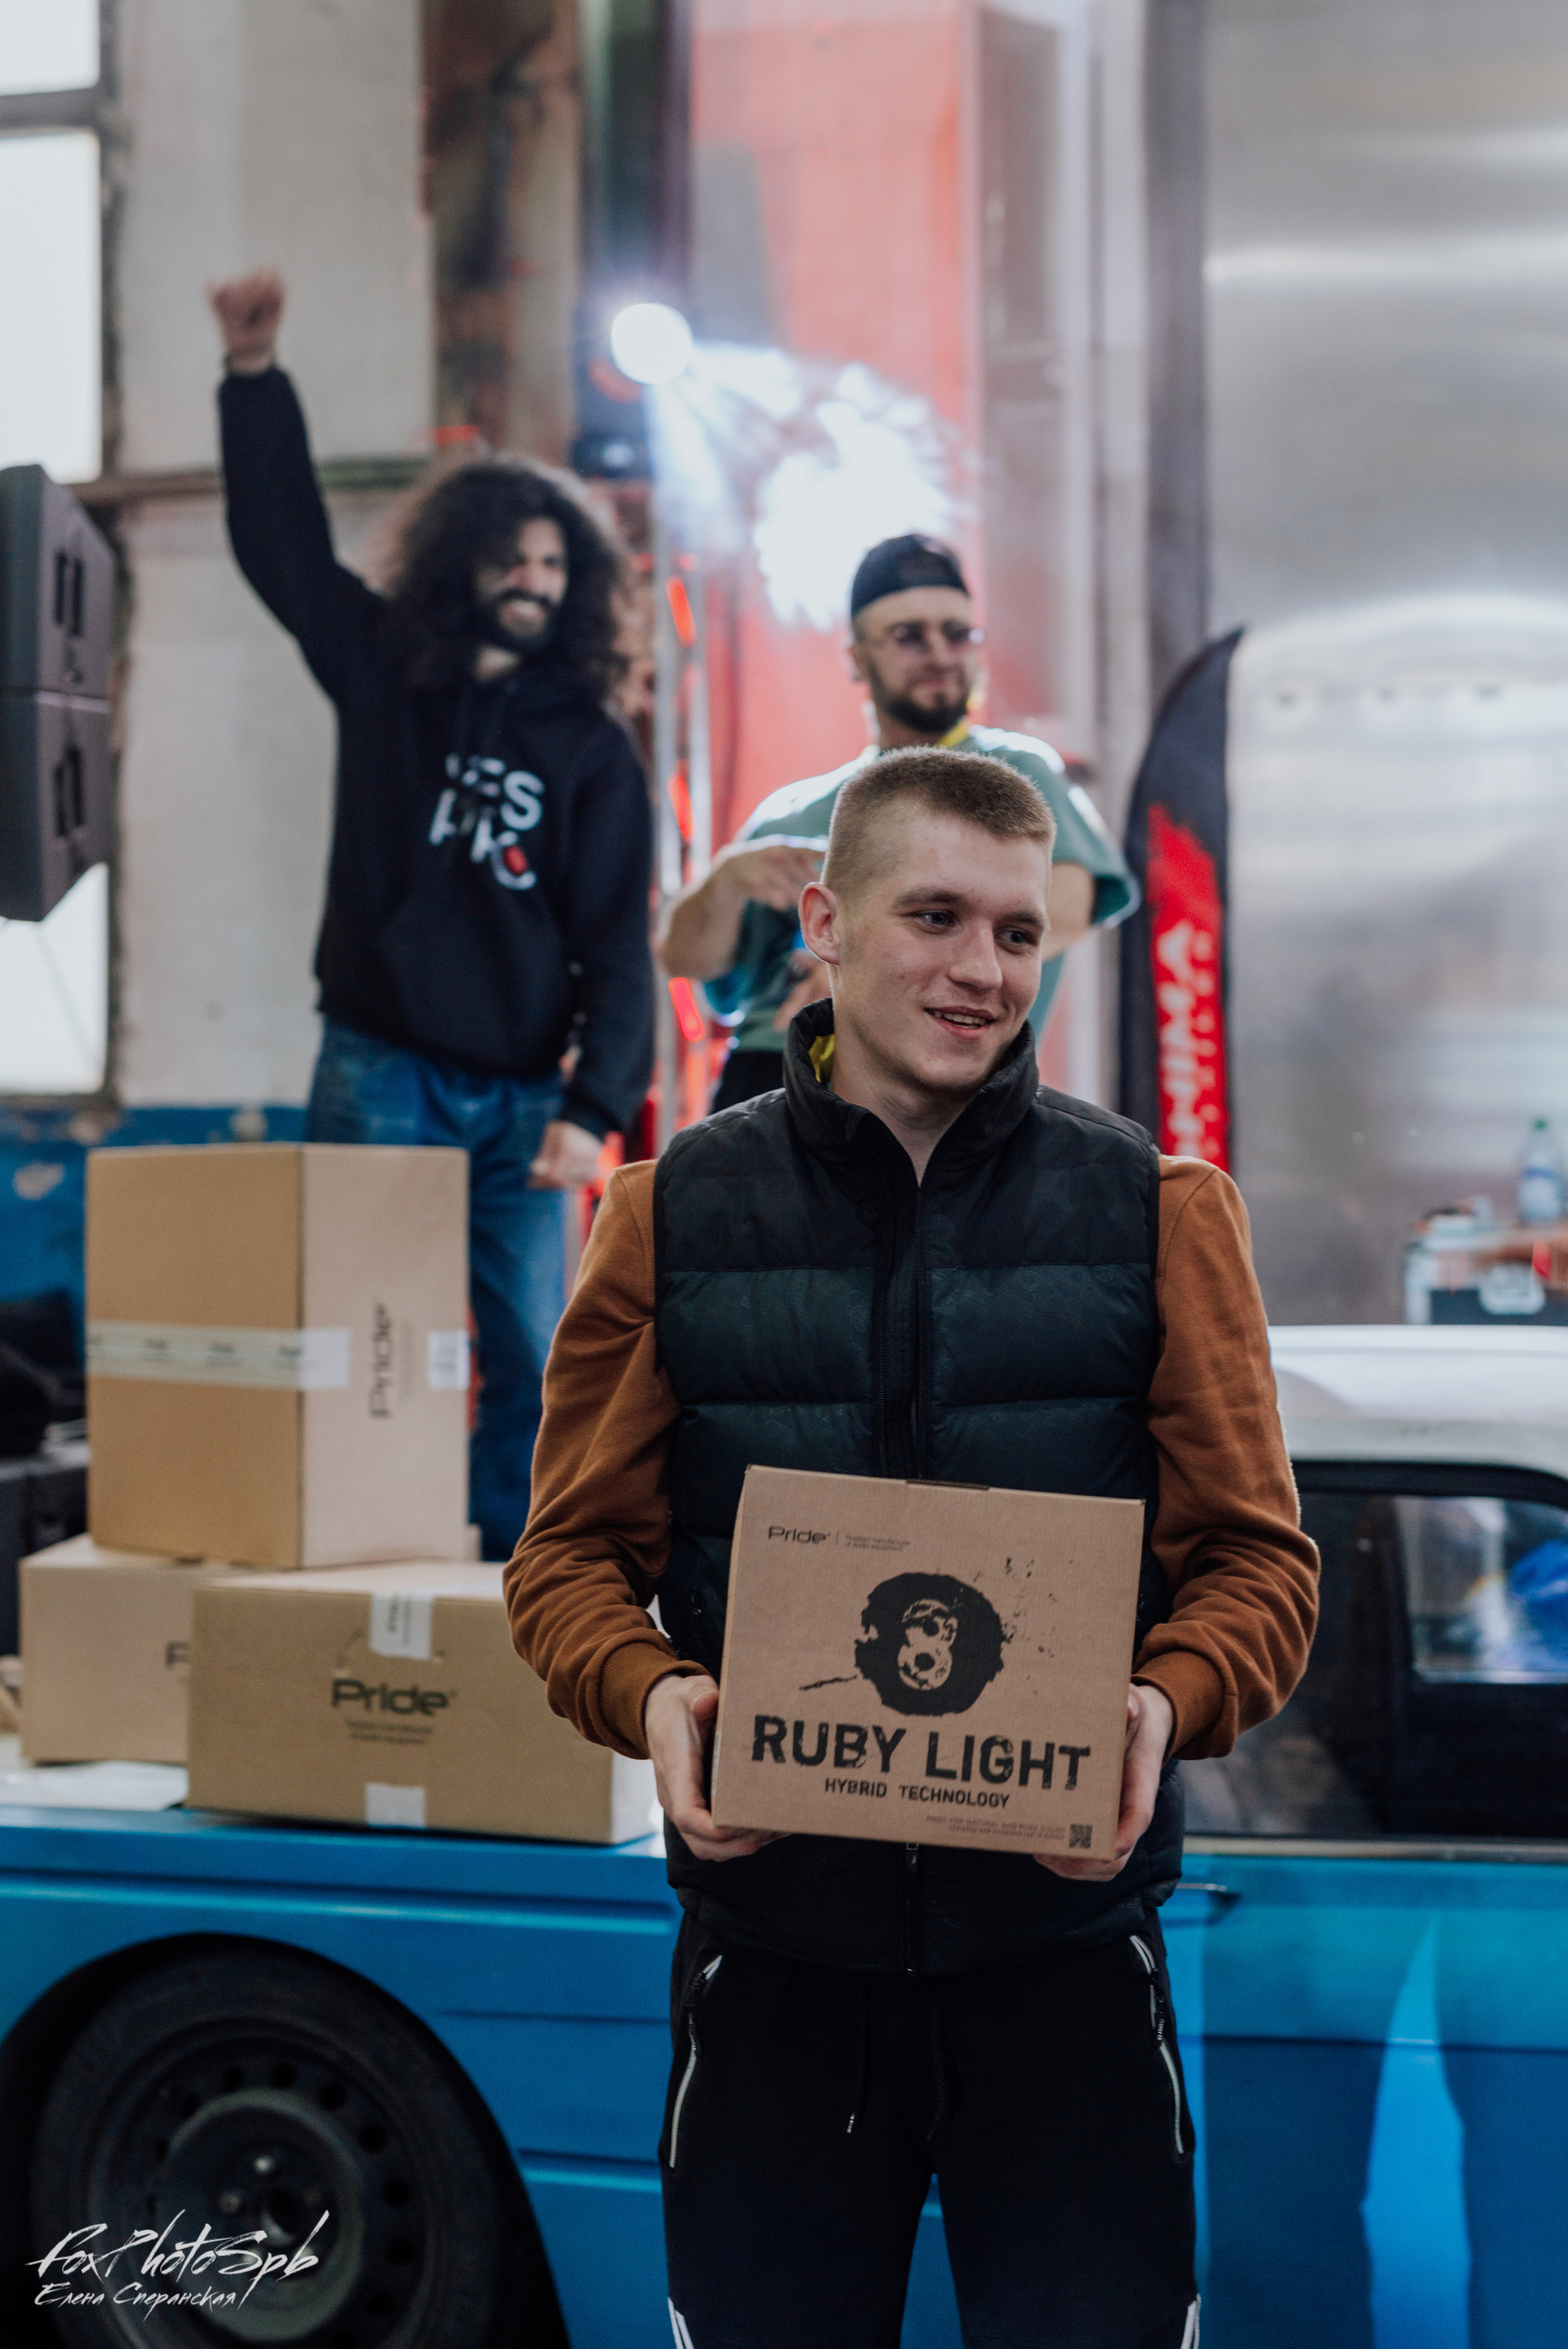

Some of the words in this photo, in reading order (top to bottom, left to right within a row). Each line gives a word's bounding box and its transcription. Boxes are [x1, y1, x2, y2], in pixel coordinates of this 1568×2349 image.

[768, 1525, 826, 1545] Pride
[331, 1678, 450, 1716] Pride
[752, 1714, 907, 1774] RUBY
[925, 1731, 1091, 1790] LIGHT
[824, 1777, 888, 1798] HYBRID
[899, 1784, 1010, 1809] TECHNOLOGY
